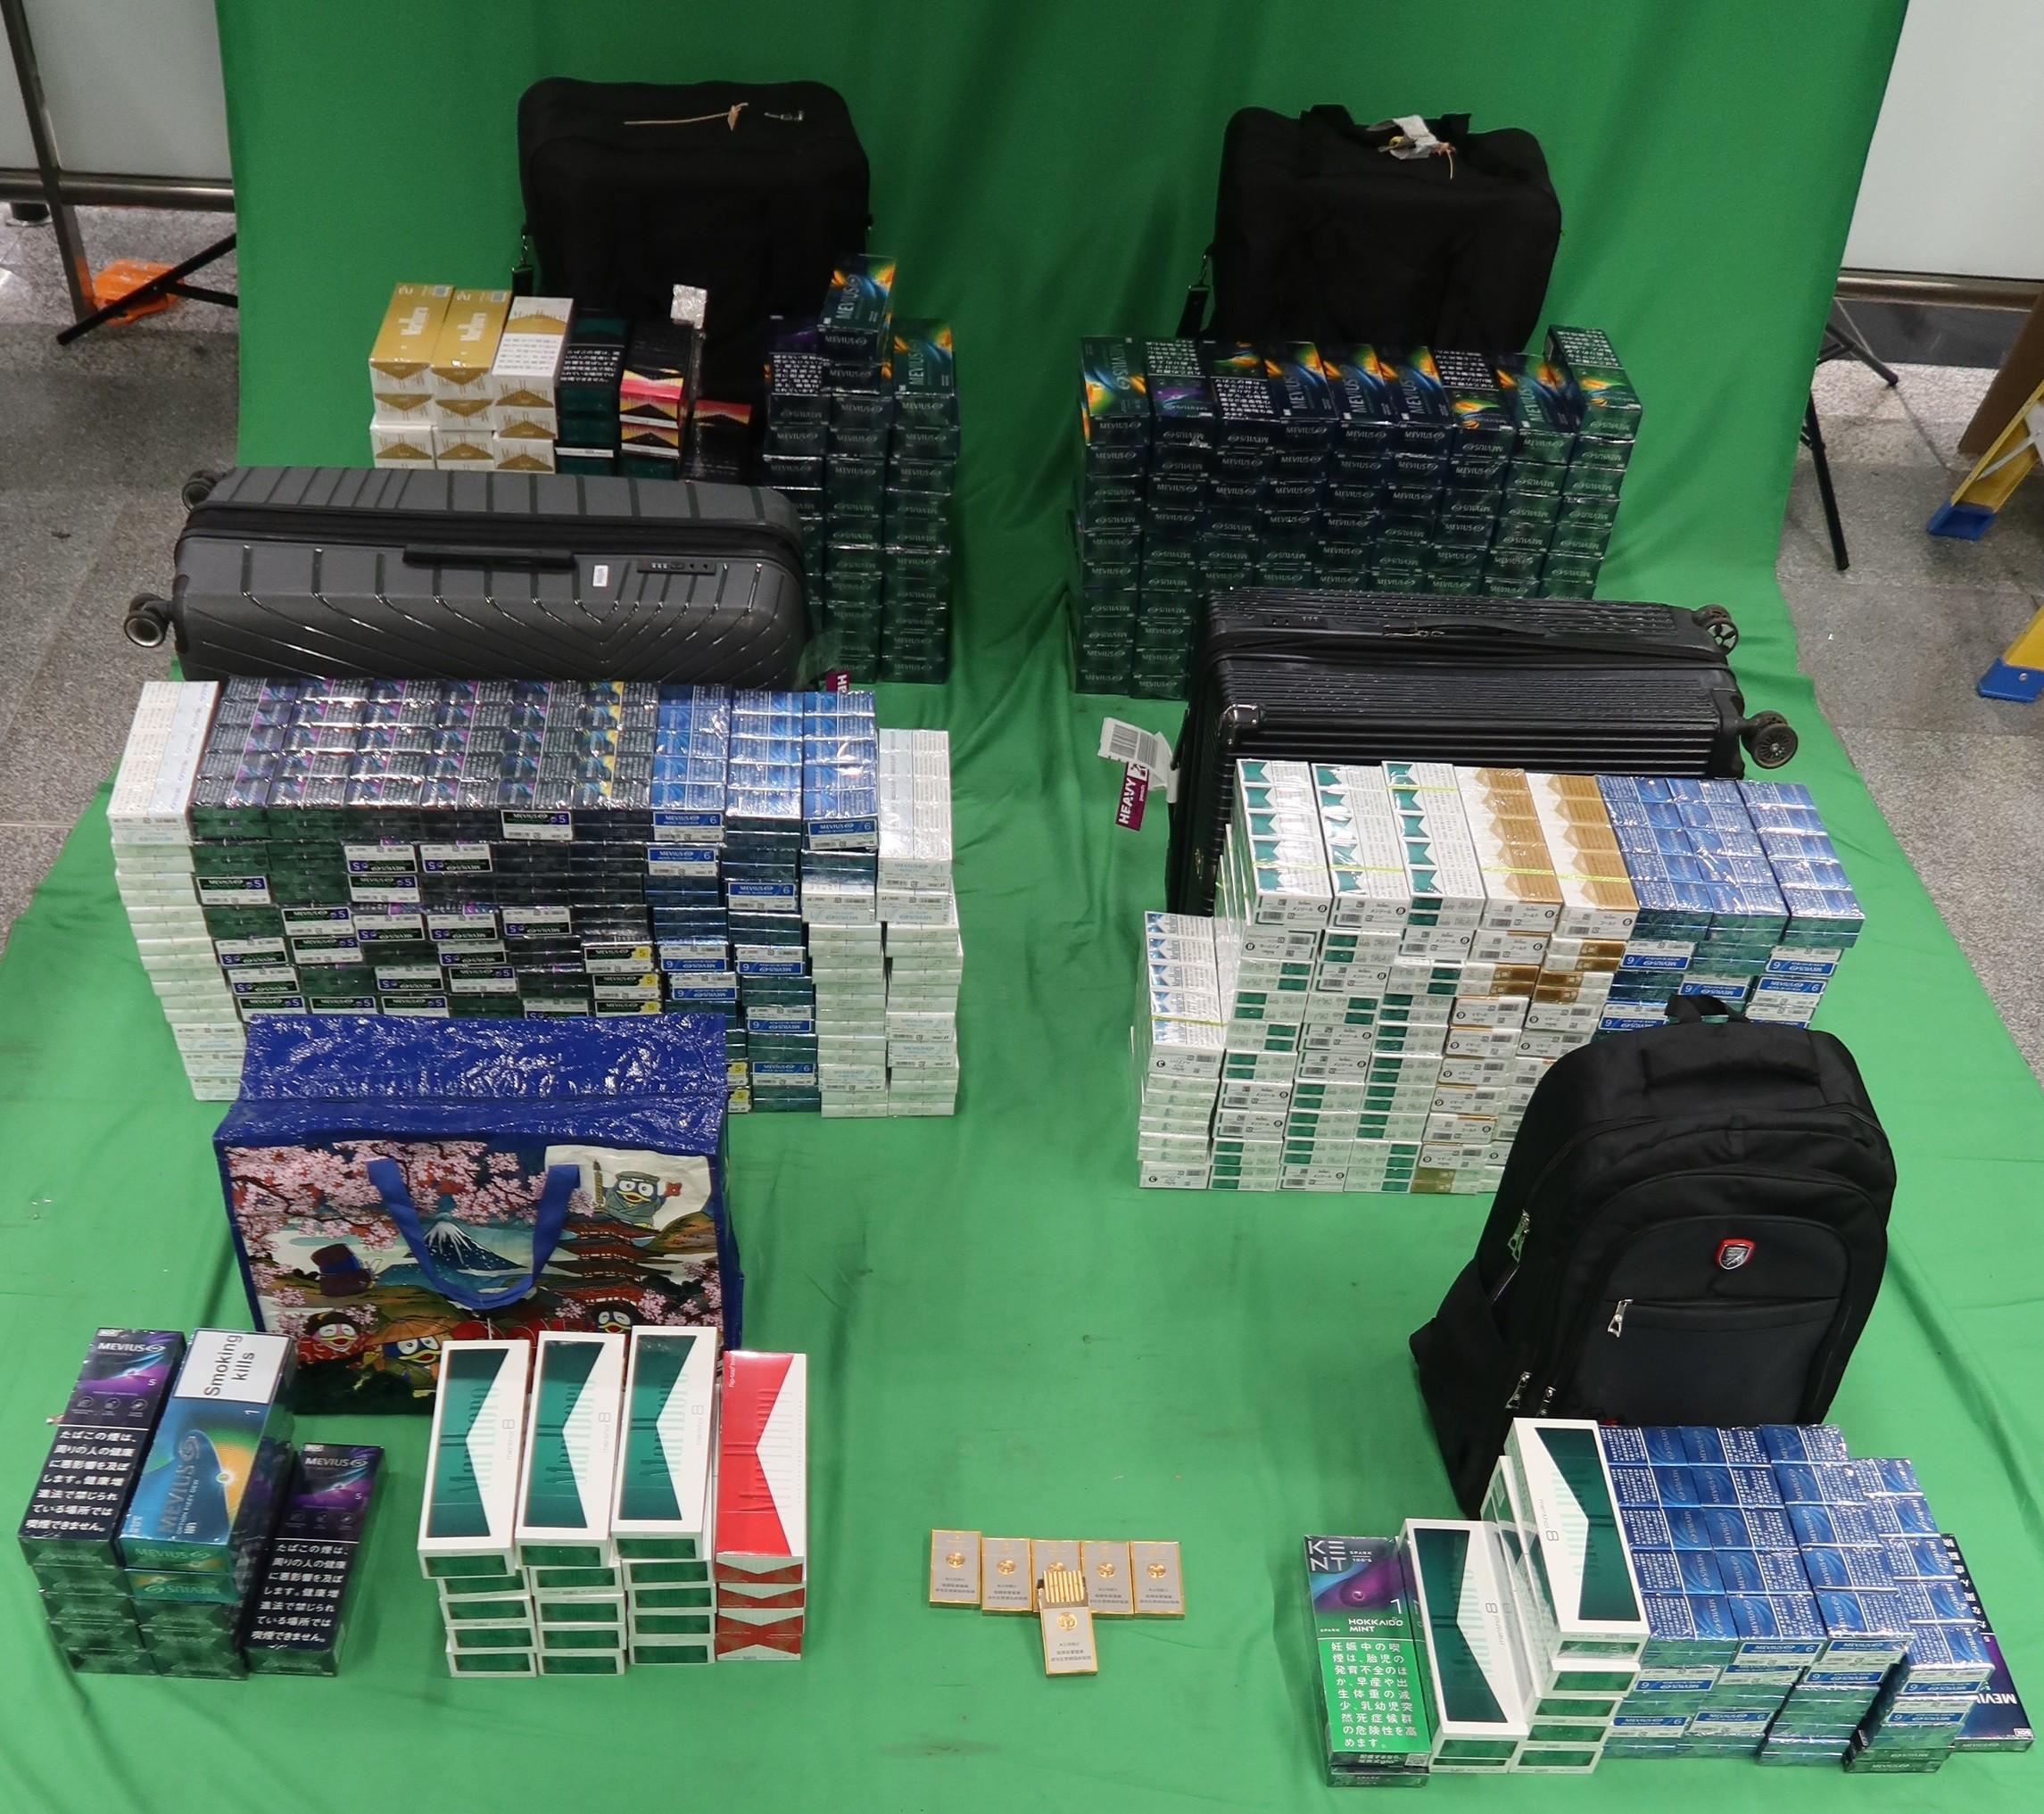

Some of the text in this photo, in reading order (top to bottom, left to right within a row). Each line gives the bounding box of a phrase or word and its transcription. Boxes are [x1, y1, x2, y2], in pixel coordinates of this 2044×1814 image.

[825, 335, 856, 344] MEVIUS
[1345, 431, 1375, 439] MEVIUS
[1341, 461, 1369, 469] MEVIUS
[1398, 462, 1427, 470] MEVIUS
[1118, 778, 1136, 824] HEAVY
[559, 816, 566, 824] 5
[865, 822, 871, 830] 6
[704, 852, 710, 860] 6
[254, 880, 261, 888] 5
[406, 878, 412, 886] 5
[783, 886, 790, 894] 6
[339, 910, 345, 918] 5
[293, 998, 300, 1006] 5
[98, 1342, 145, 1352] MEVIUS
[203, 1334, 243, 1396] Smoking
[232, 1352, 254, 1381] kills
[60, 1431, 137, 1442] たばこの煙は、
[54, 1445, 135, 1457] 周りの人の健康
[48, 1459, 130, 1471] に悪影響を及ぼ
[305, 1457, 349, 1467] MEVIUS
[43, 1474, 125, 1487] します。健康増
[37, 1489, 119, 1501] 進法で禁じられ
[158, 1465, 195, 1533] MEVIUS
[32, 1504, 113, 1516] ている場所では
[26, 1519, 106, 1532] 喫煙できません。
[135, 1548, 188, 1559] MEVIUS
[277, 1545, 348, 1555] たばこの煙は、
[272, 1558, 346, 1570] 周りの人の健康
[268, 1572, 343, 1583] に悪影響を及ぼ
[168, 1585, 219, 1594] MEVIUS
[264, 1586, 340, 1598] します。健康増
[261, 1601, 335, 1612] 進法で禁じられ
[1390, 1599, 1402, 1614] 1
[256, 1616, 332, 1627] ている場所では
[1348, 1618, 1403, 1626] HOKKAIDO
[252, 1630, 326, 1643] 喫煙できません。
[1331, 1642, 1401, 1652] 妊娠中の喫
[1333, 1654, 1404, 1663] 煙は、胎児の
[1335, 1666, 1407, 1676] 発育不全のほ
[1336, 1677, 1408, 1687] か、早産や出
[1337, 1689, 1411, 1699] 生体重の減
[1340, 1701, 1413, 1711] 少、乳幼児突
[1341, 1713, 1412, 1723] 然死症候群
[1343, 1725, 1418, 1735] の危険性を高
[1344, 1737, 1386, 1748] めます。
